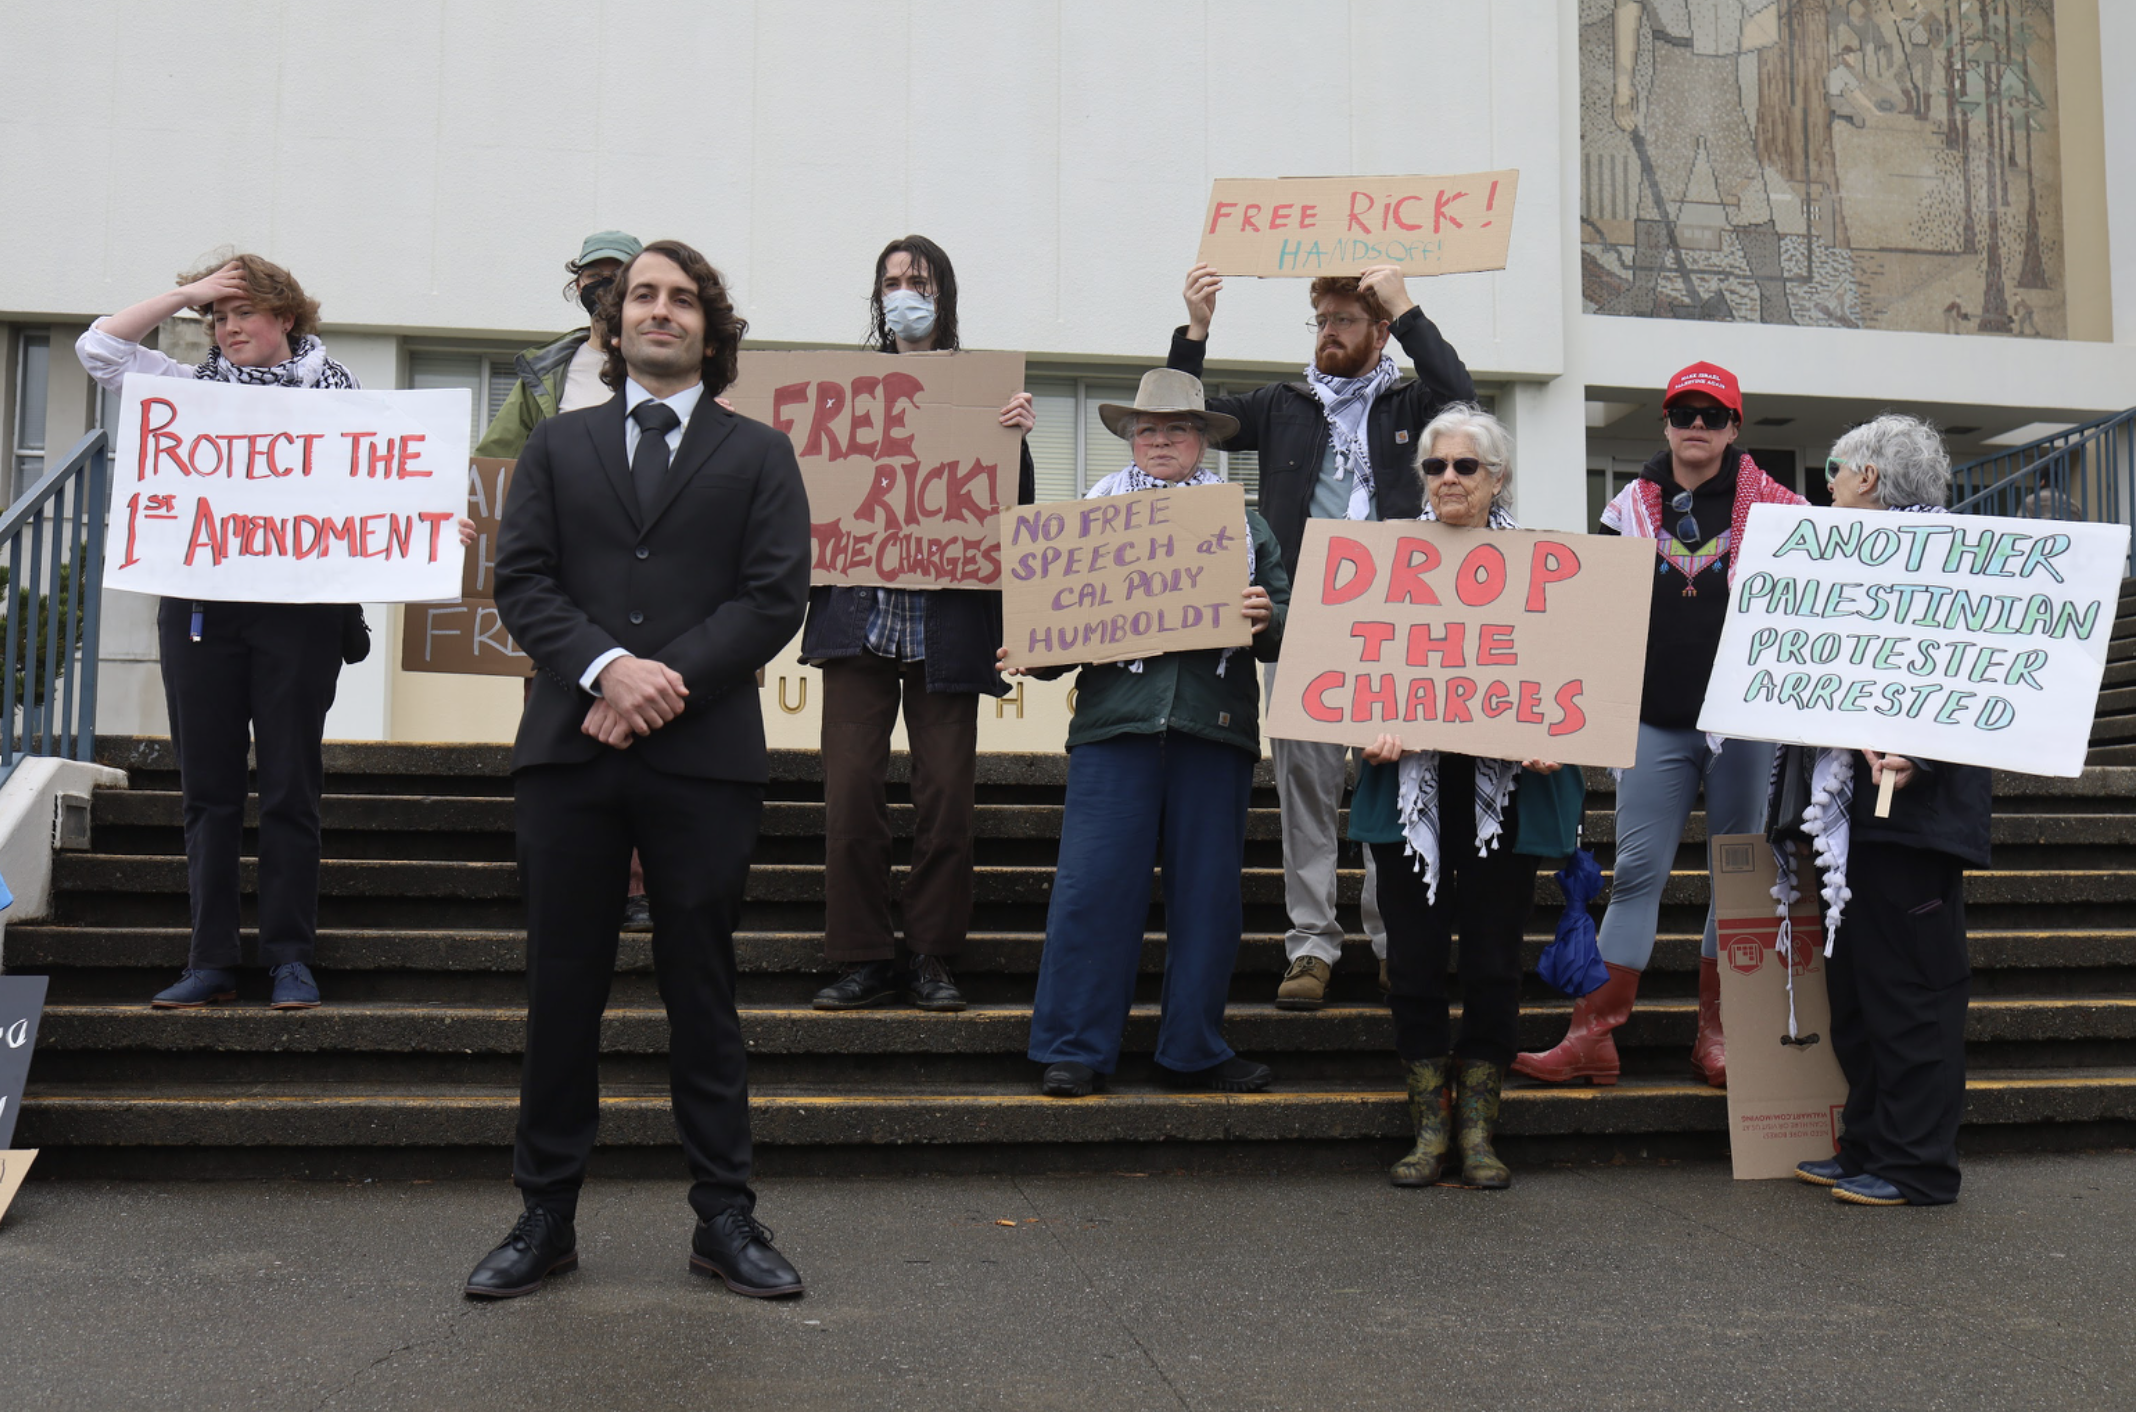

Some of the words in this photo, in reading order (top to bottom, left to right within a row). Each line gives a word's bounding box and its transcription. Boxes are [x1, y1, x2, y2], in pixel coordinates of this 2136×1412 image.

[1208, 201, 1319, 234] FREE
[138, 397, 325, 482] PROTECT
[340, 431, 434, 480] THE
[773, 371, 925, 462] FREE
[853, 457, 1000, 533] RICK!
[1012, 510, 1066, 546] NO
[1078, 497, 1171, 538] FREE
[183, 496, 455, 566] AMENDMENT
[810, 517, 878, 578] THE
[875, 529, 1002, 585] CHARGES
[1011, 534, 1175, 581] SPEECH
[1196, 525, 1235, 555] at
[1773, 518, 2070, 584] ANOTHER
[1051, 582, 1113, 611] CAL
[1122, 566, 1204, 601] POLY
[1321, 536, 1581, 613] DROP
[1738, 571, 2101, 640] PALESTINIAN
[1028, 602, 1231, 653] HUMBOLDT
[1350, 621, 1518, 668] THE
[1747, 627, 2049, 690] PROTESTER
[1301, 670, 1586, 736] CHARGES
[1743, 669, 2016, 731] ARRESTED
